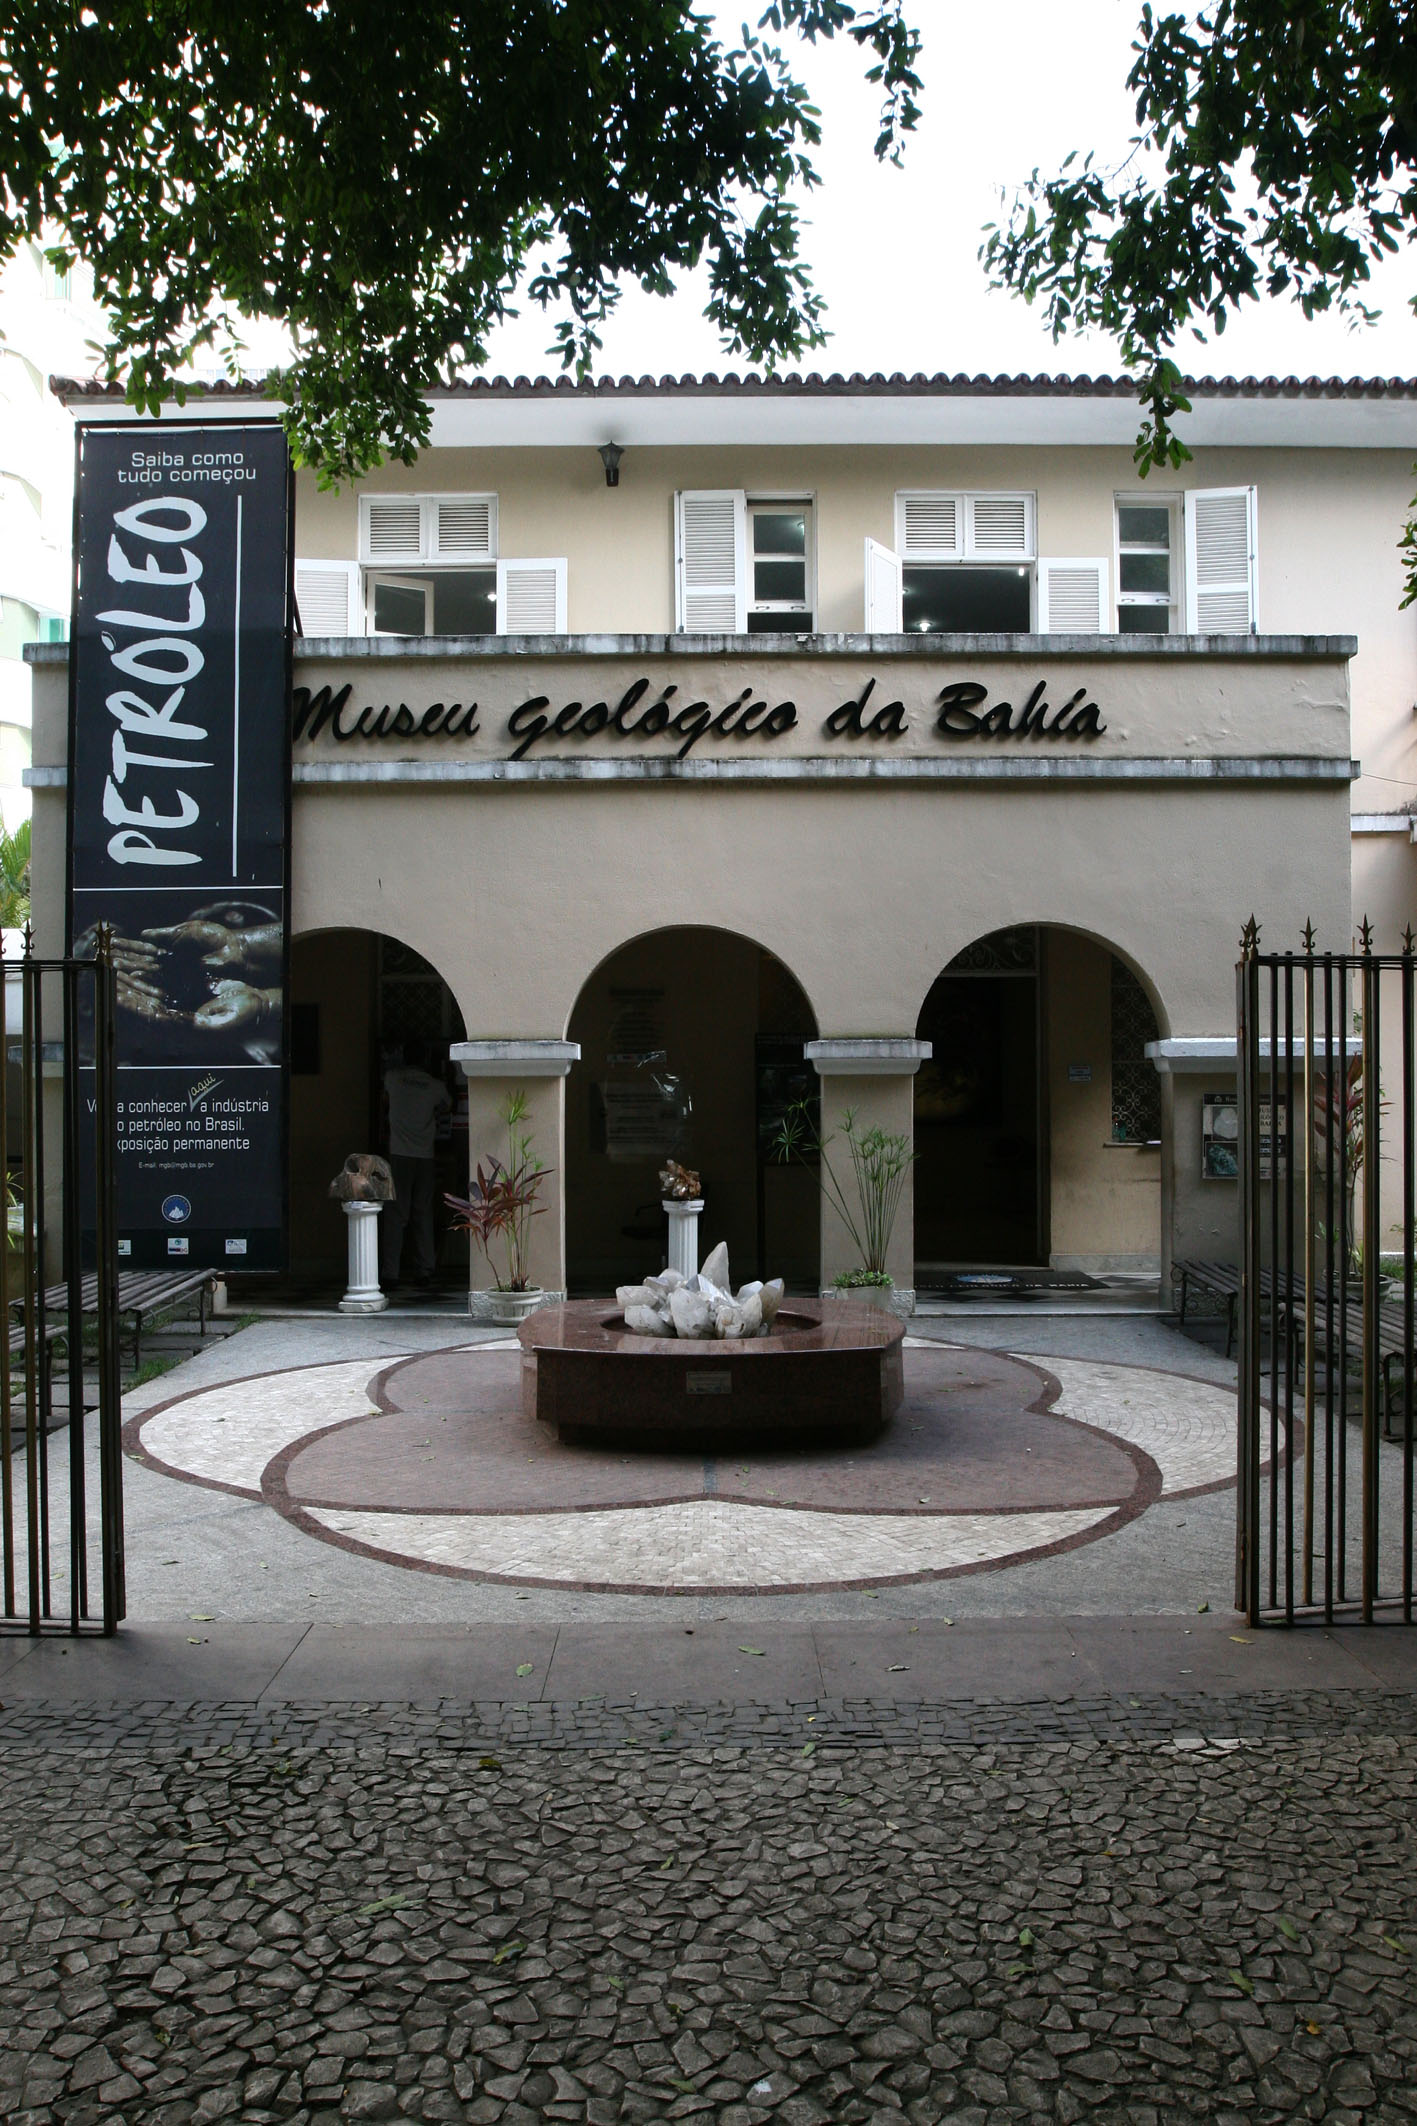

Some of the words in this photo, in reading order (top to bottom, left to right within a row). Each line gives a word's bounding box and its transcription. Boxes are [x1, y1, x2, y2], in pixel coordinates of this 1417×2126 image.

[131, 451, 184, 467] Saiba
[192, 452, 244, 466] como
[117, 467, 162, 483] tudo
[169, 468, 257, 485] começou
[95, 496, 214, 866] PETRÓLEO
[292, 683, 480, 742] Museu
[826, 677, 909, 736] da
[935, 680, 1107, 738] Bahia
[190, 1073, 216, 1096] aqui
[128, 1098, 187, 1113] conhecer
[200, 1102, 208, 1113] a
[212, 1098, 269, 1113] indústria
[128, 1117, 181, 1134] petróleo
[185, 1120, 200, 1131] no
[205, 1117, 245, 1131] Brasil.
[173, 1137, 250, 1152] permanente
